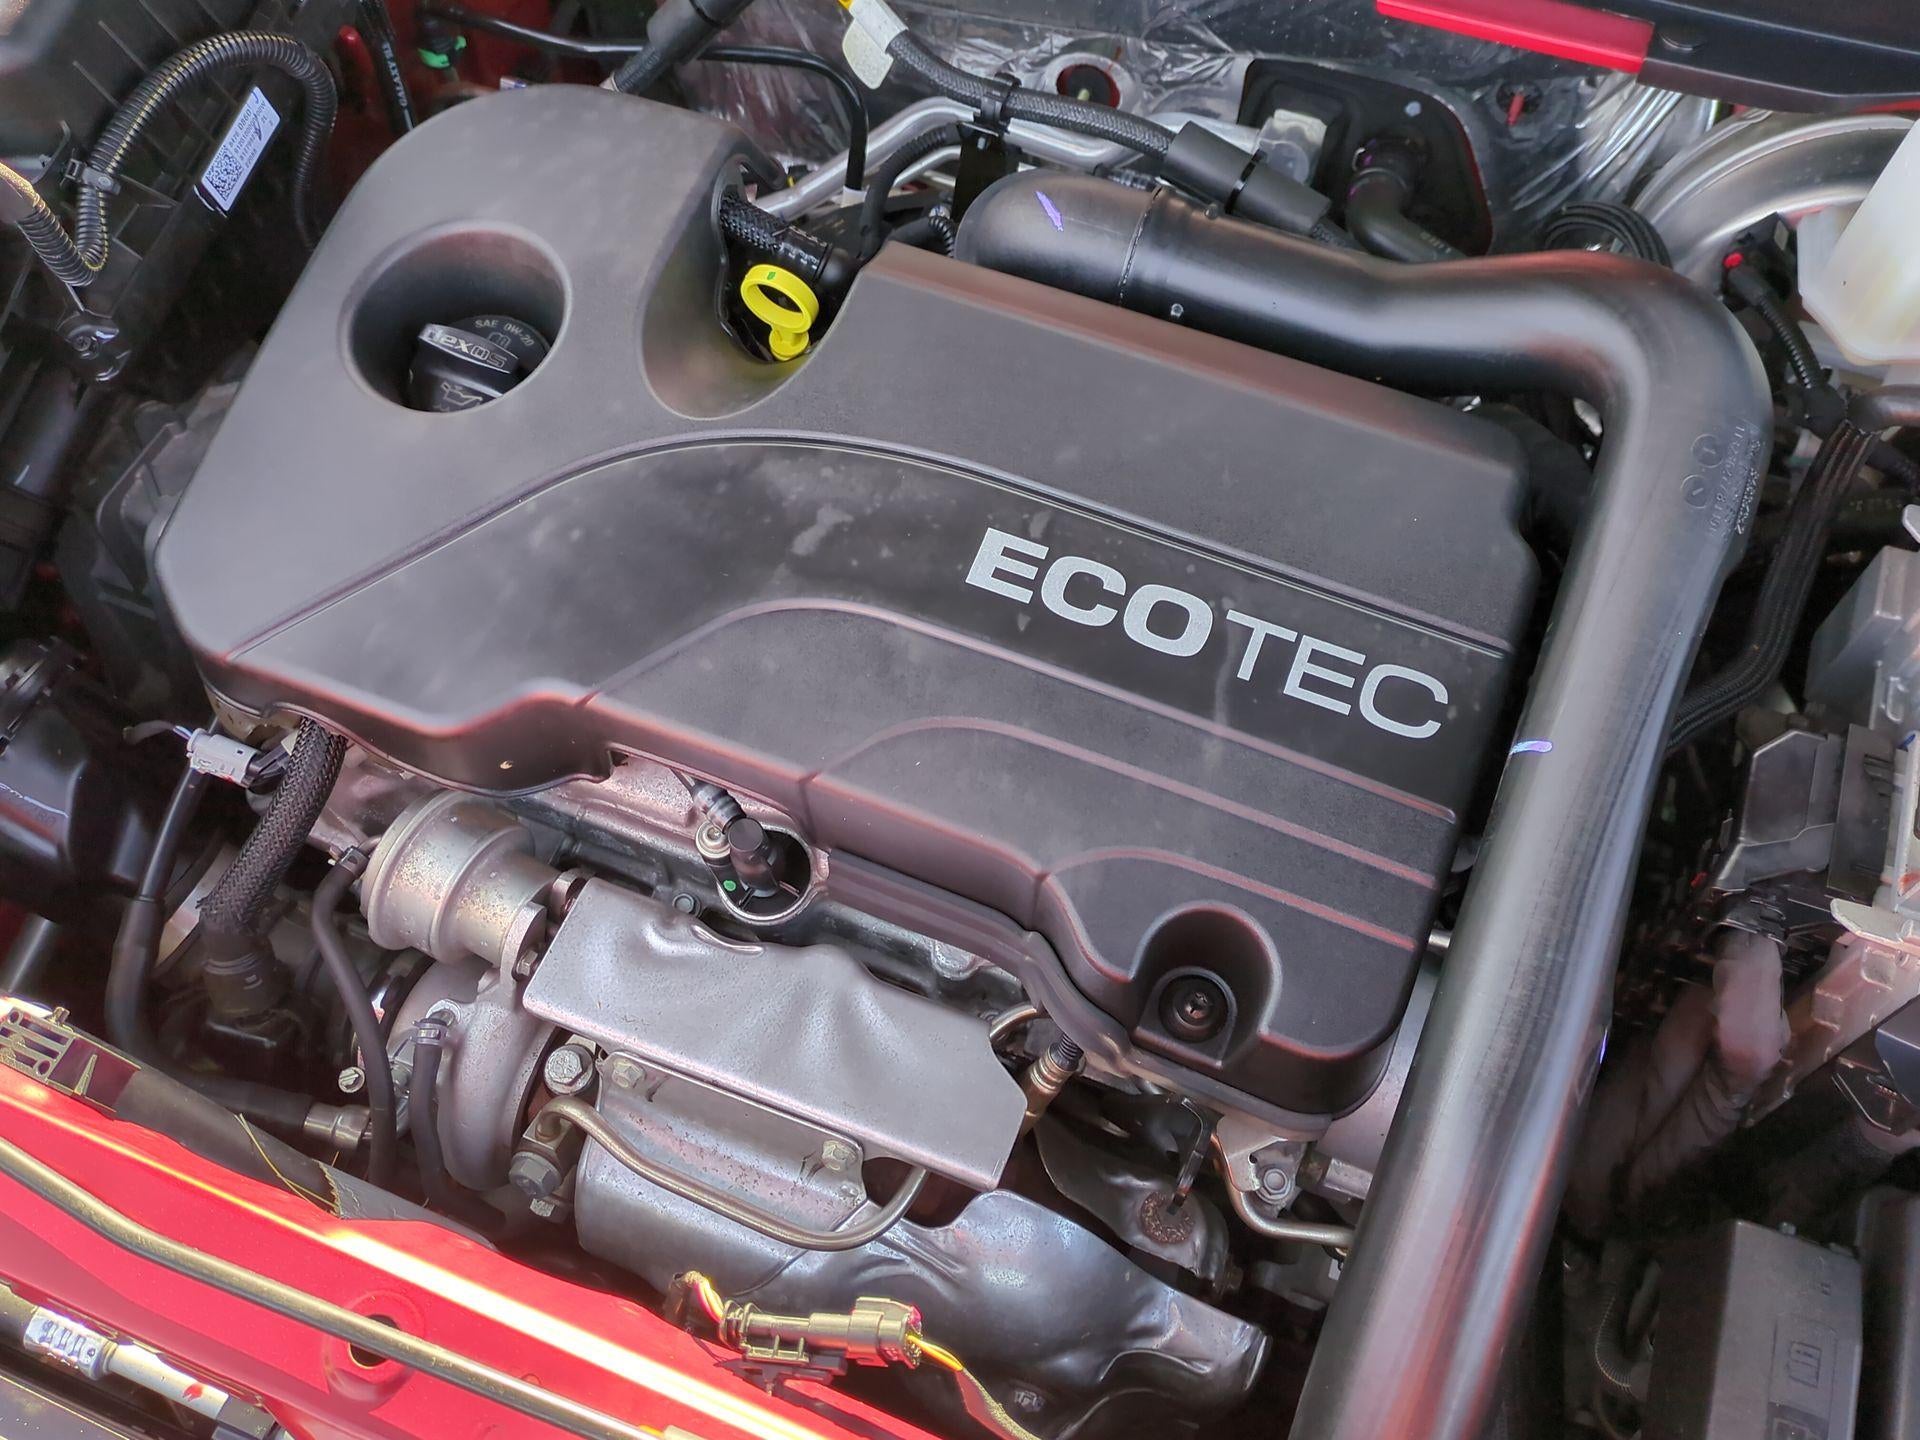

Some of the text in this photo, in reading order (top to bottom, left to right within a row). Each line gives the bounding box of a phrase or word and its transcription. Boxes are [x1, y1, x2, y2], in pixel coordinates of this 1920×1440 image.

[475, 320, 534, 346] SAE 0W-20
[965, 527, 1449, 739] ECOTEC
